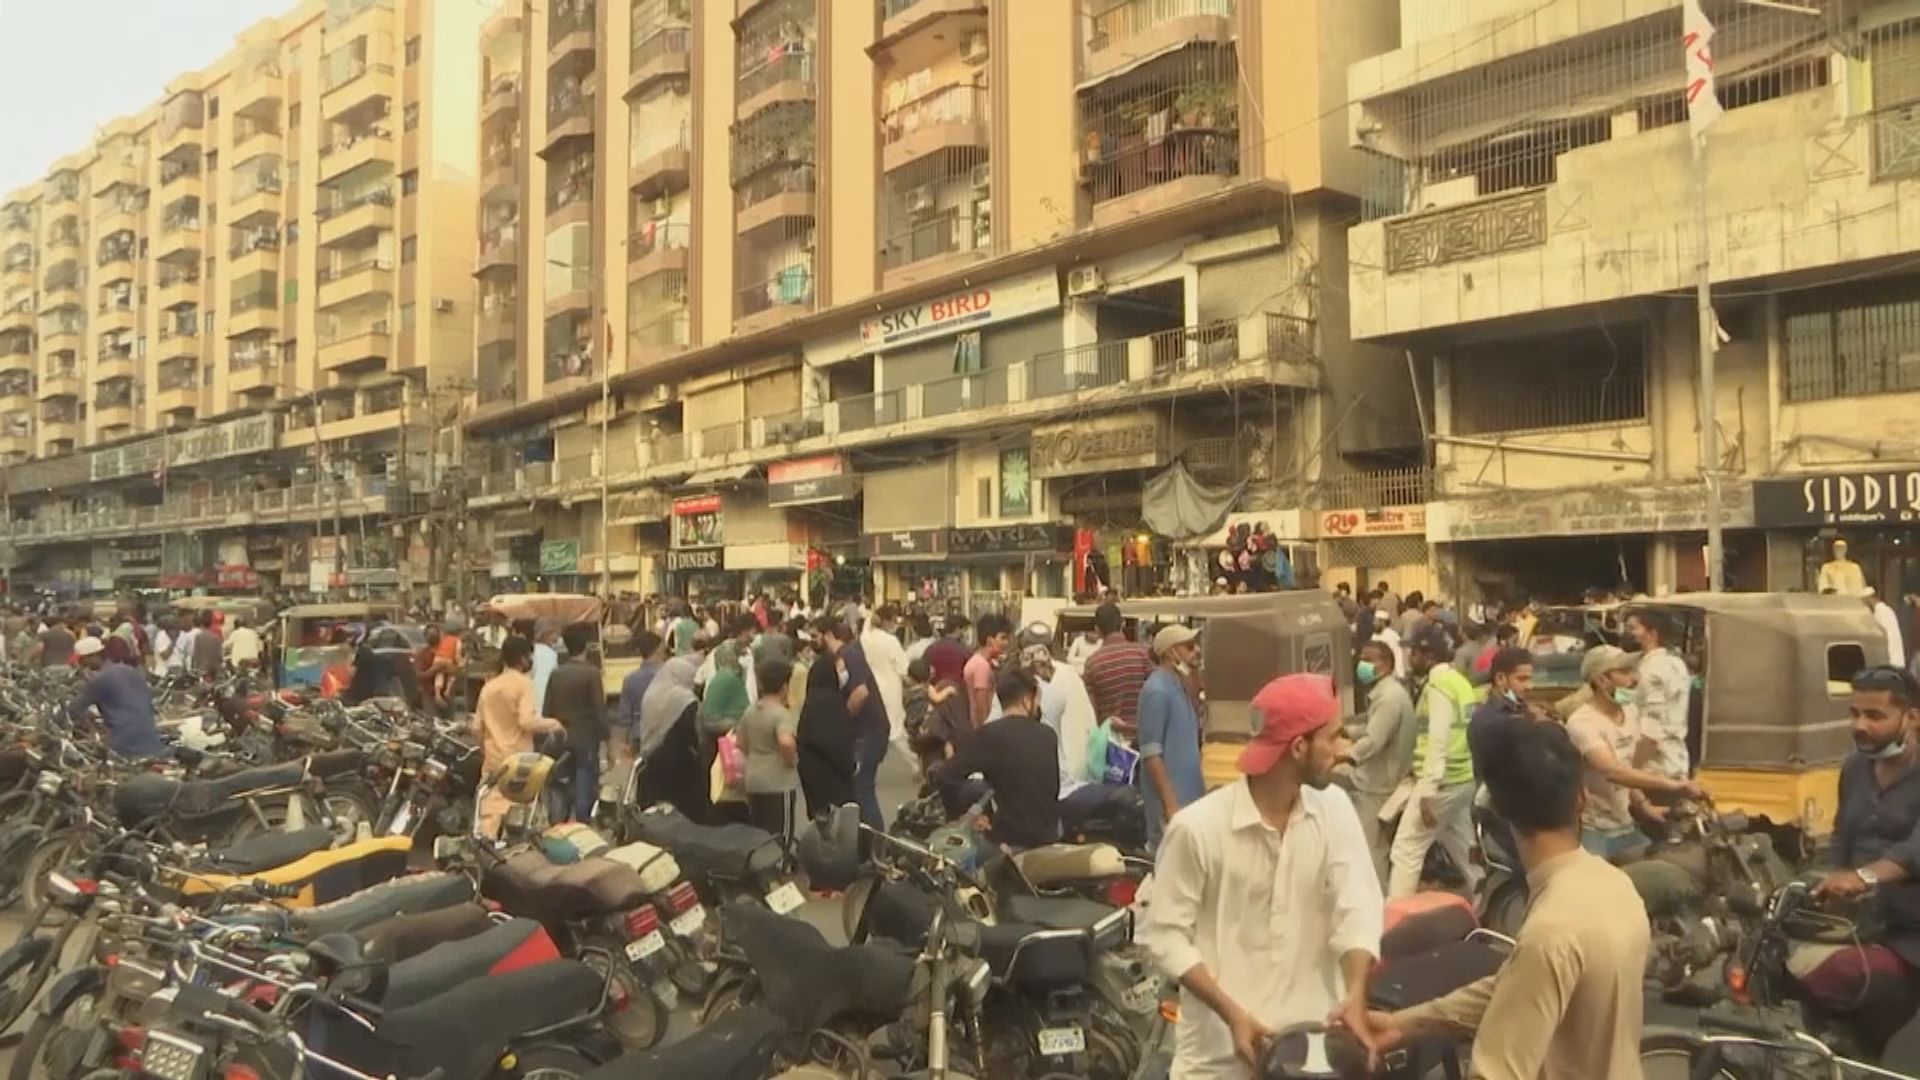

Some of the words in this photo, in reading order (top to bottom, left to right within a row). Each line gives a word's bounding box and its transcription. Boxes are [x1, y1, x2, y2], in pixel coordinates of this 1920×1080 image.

[881, 305, 922, 334] SKY
[931, 287, 991, 321] BIRD
[680, 551, 716, 569] DINERS
